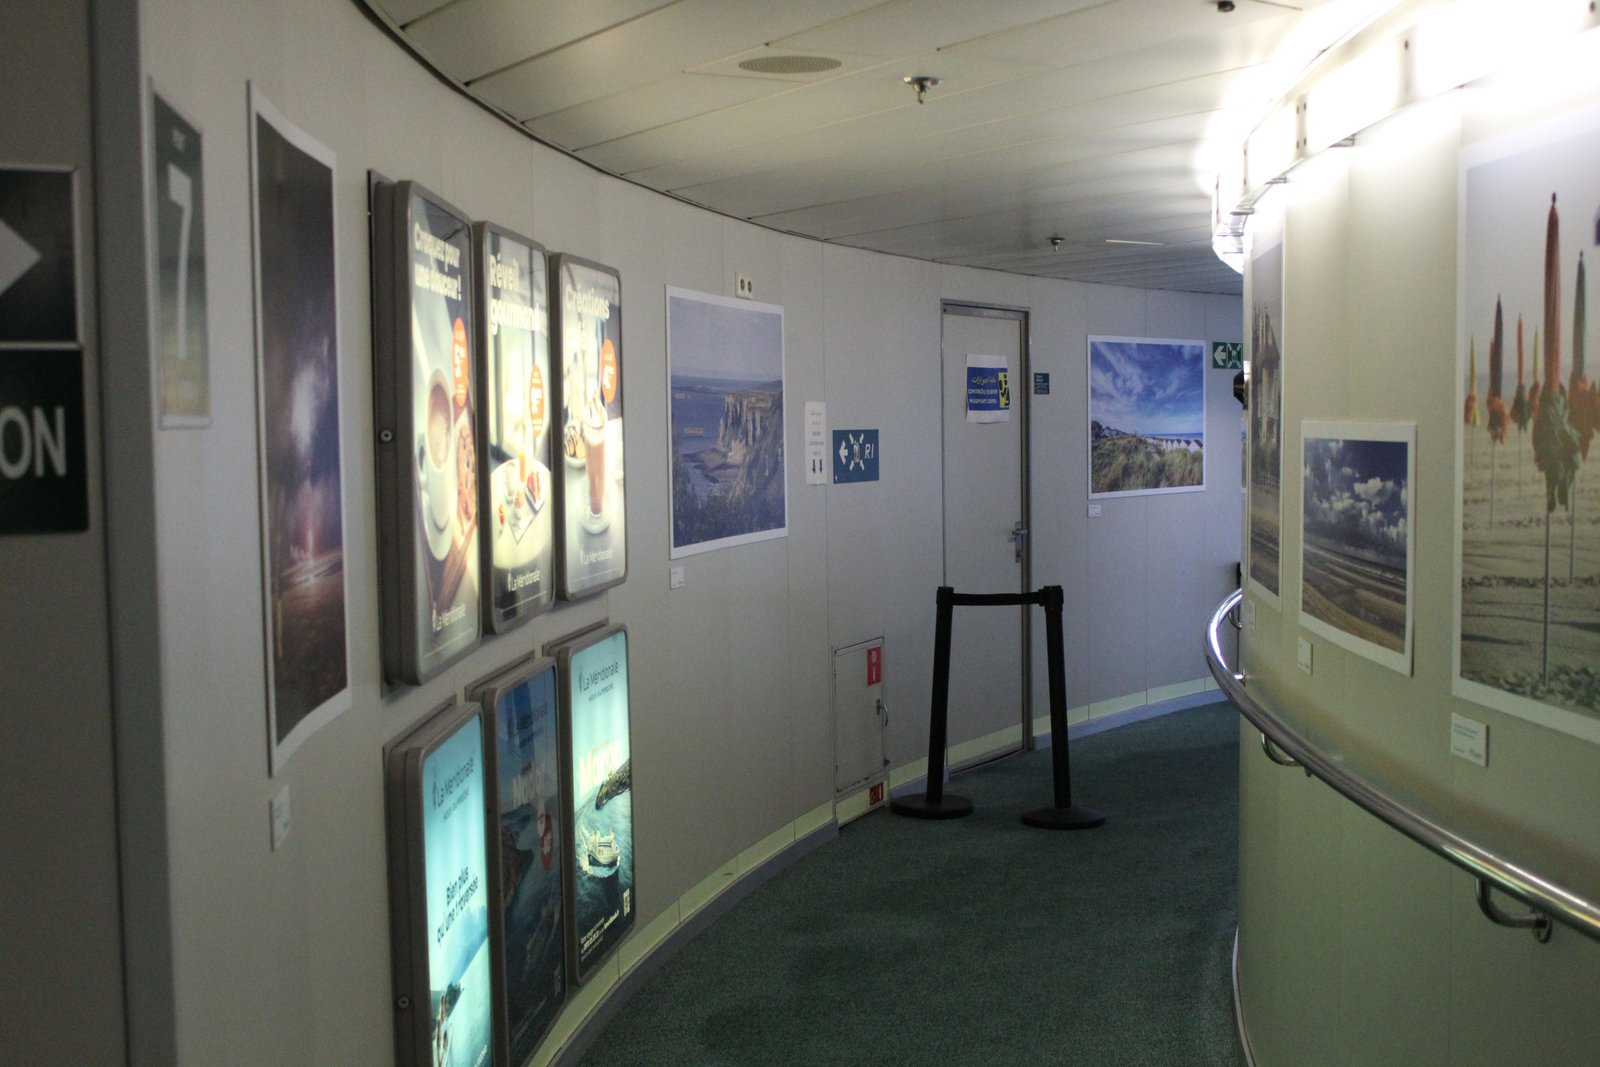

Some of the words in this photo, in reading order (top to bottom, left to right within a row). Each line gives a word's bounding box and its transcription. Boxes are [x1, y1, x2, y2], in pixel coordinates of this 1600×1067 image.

[489, 253, 519, 292] Réveil
[490, 298, 540, 336] gourmand
[565, 282, 610, 320] Créations
[0, 405, 67, 480] ON
